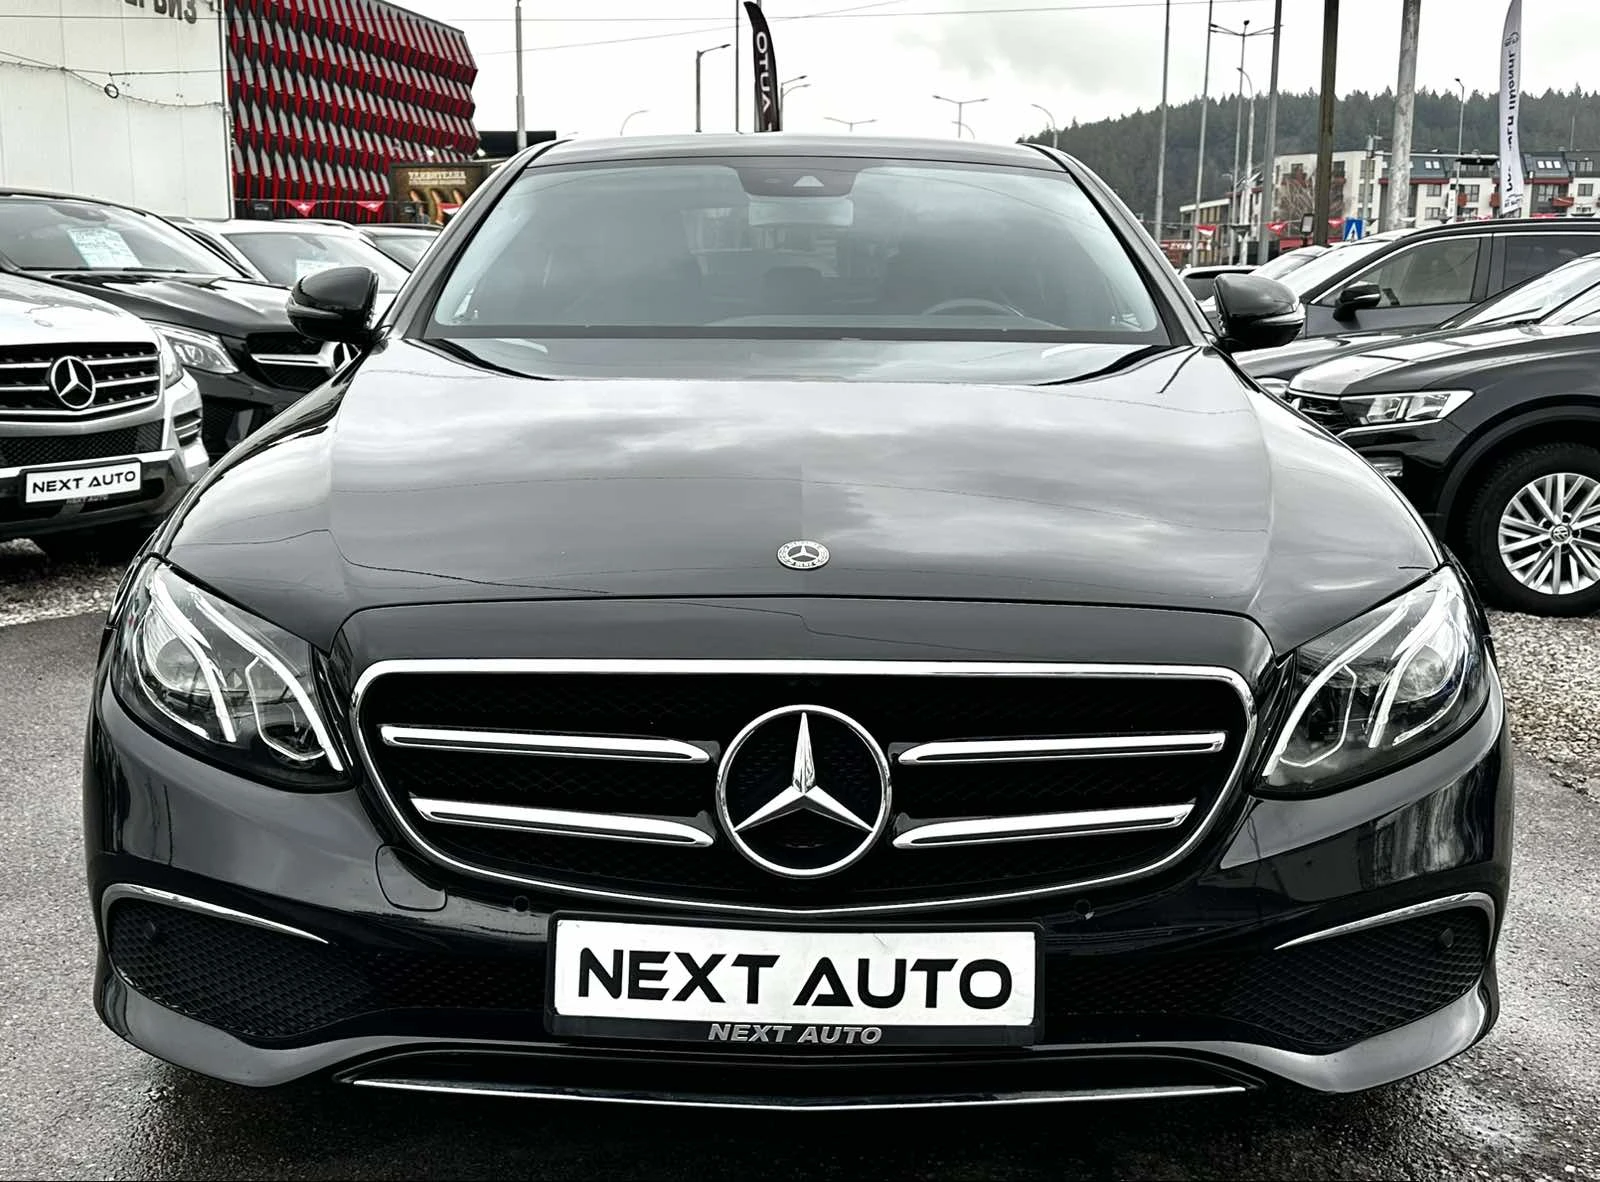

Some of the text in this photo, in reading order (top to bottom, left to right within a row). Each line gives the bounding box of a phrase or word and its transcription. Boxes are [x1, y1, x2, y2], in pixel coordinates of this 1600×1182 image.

[32, 471, 136, 494] NEXT AUTO
[578, 946, 1013, 1010] NEXT AUTO
[707, 1023, 883, 1045] NEXT AUTO
